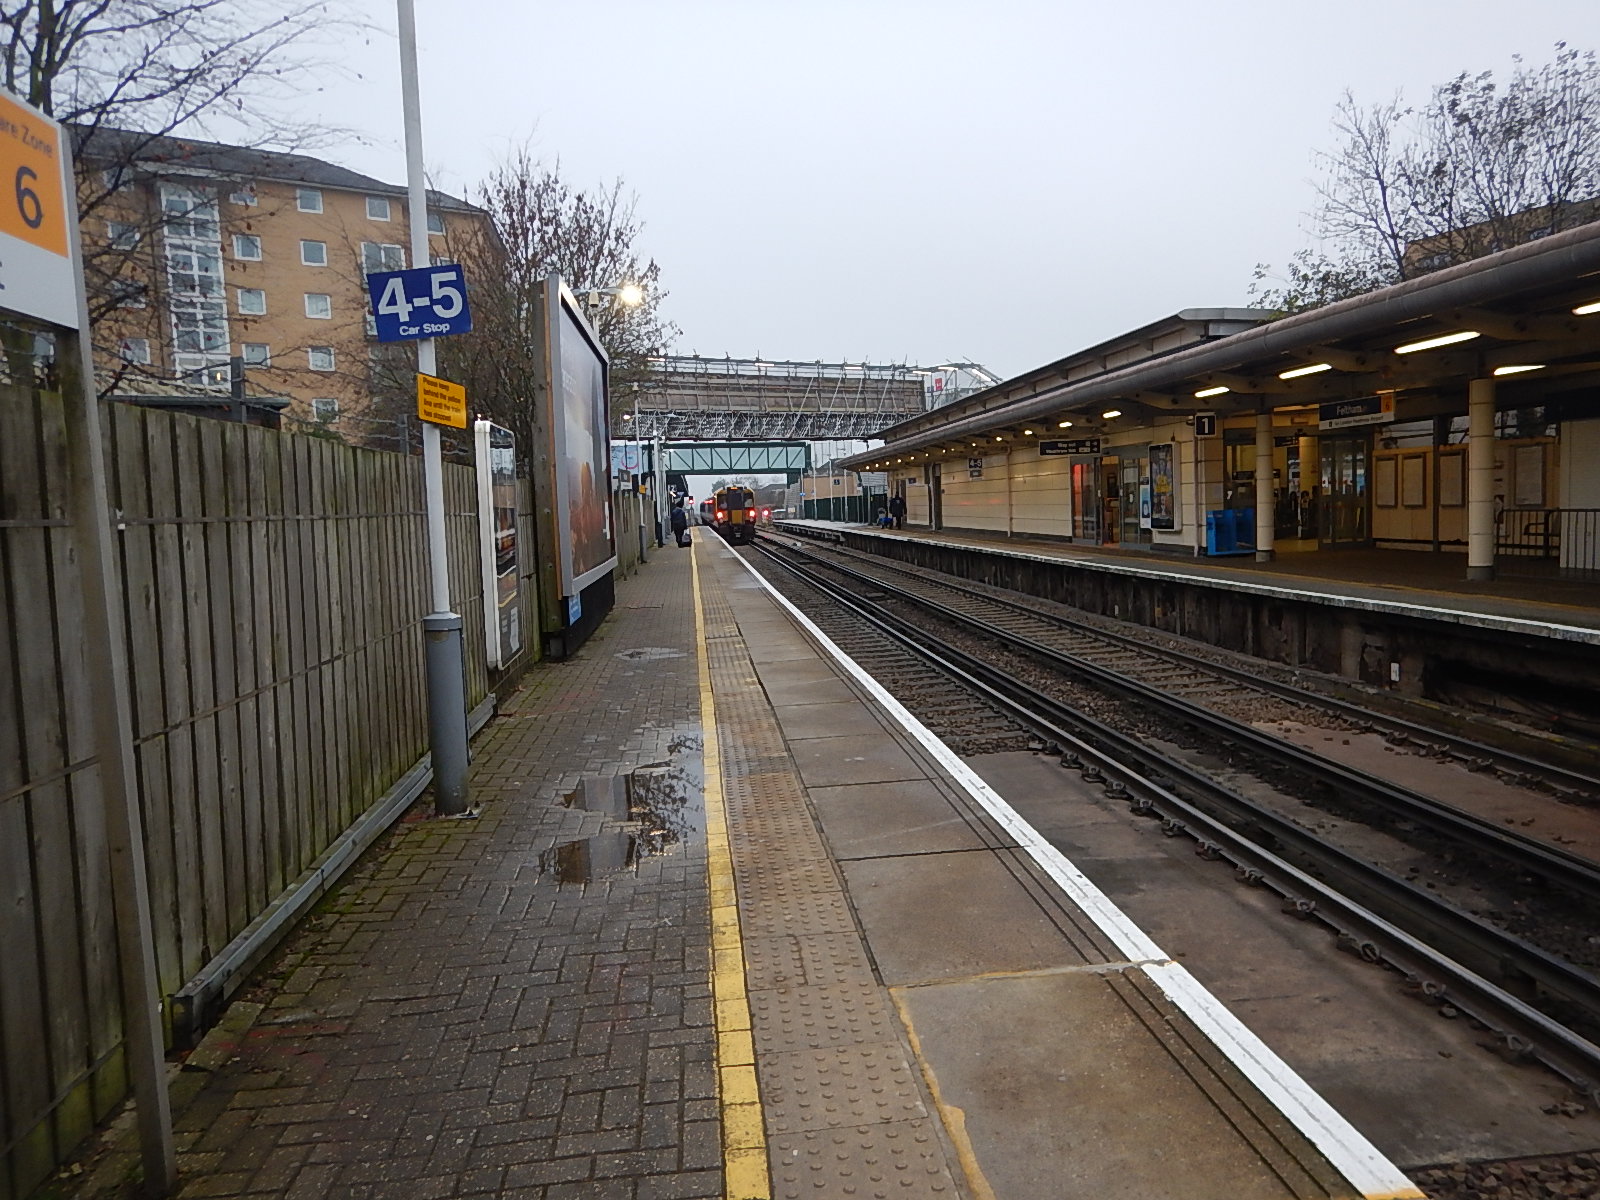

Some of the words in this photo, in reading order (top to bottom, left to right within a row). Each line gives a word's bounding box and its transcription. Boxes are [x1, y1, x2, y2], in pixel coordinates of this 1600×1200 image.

[22, 124, 52, 158] Zone
[15, 166, 43, 230] 6
[378, 271, 463, 323] 4-5
[400, 325, 420, 336] Car
[423, 322, 450, 334] Stop
[1336, 404, 1362, 415] Feltham
[1202, 418, 1209, 434] 1
[969, 459, 982, 467] 4-5
